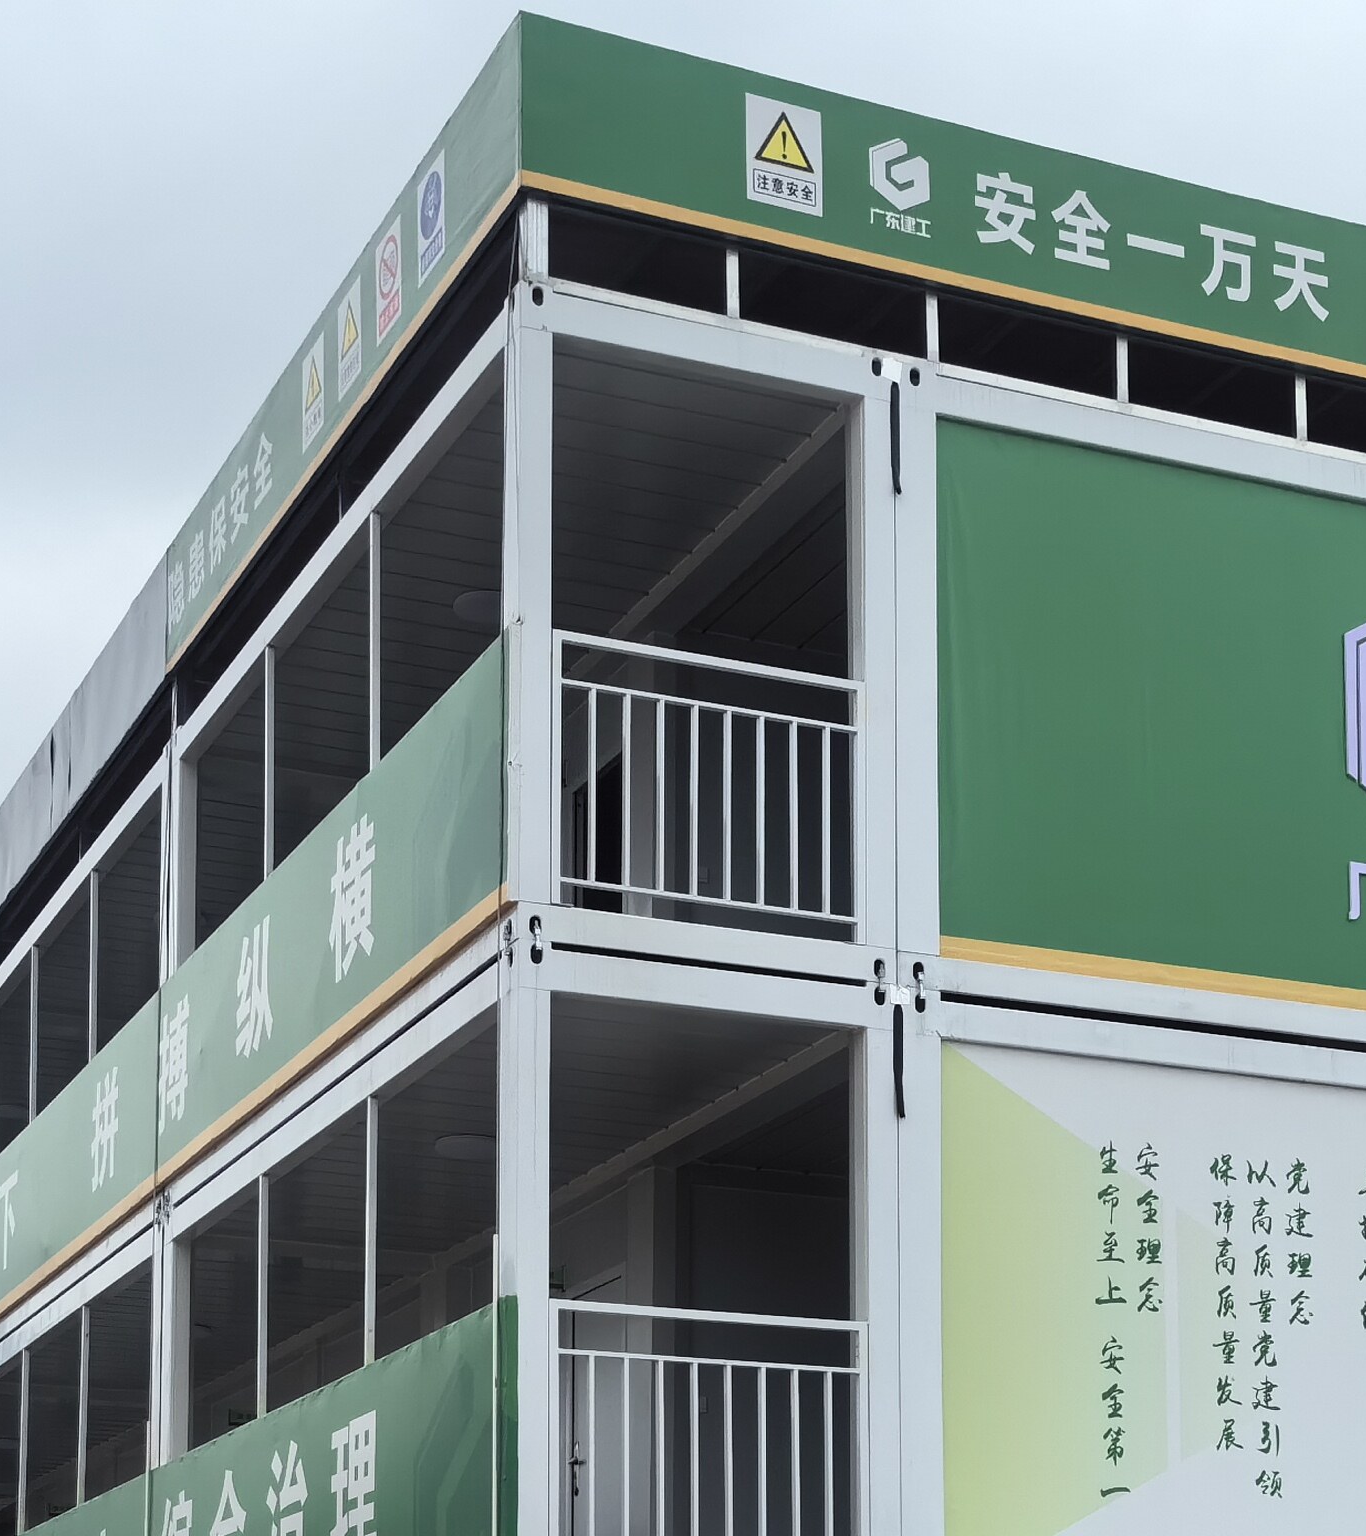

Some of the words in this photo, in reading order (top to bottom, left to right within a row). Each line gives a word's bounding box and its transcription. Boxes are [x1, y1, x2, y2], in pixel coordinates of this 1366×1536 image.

[757, 173, 814, 202] 注意安全
[869, 207, 932, 239] 广东建工
[974, 171, 1329, 322] 安全一万天
[91, 813, 377, 1193] 拼搏纵横
[1094, 1139, 1128, 1306] 生命至上
[1134, 1142, 1164, 1314] 安全理念
[1209, 1153, 1244, 1452] 保障高质量发展
[1285, 1157, 1315, 1326] 党建理念
[1246, 1159, 1284, 1500] 以高质量党建引领
[1099, 1335, 1132, 1499] 安全第一
